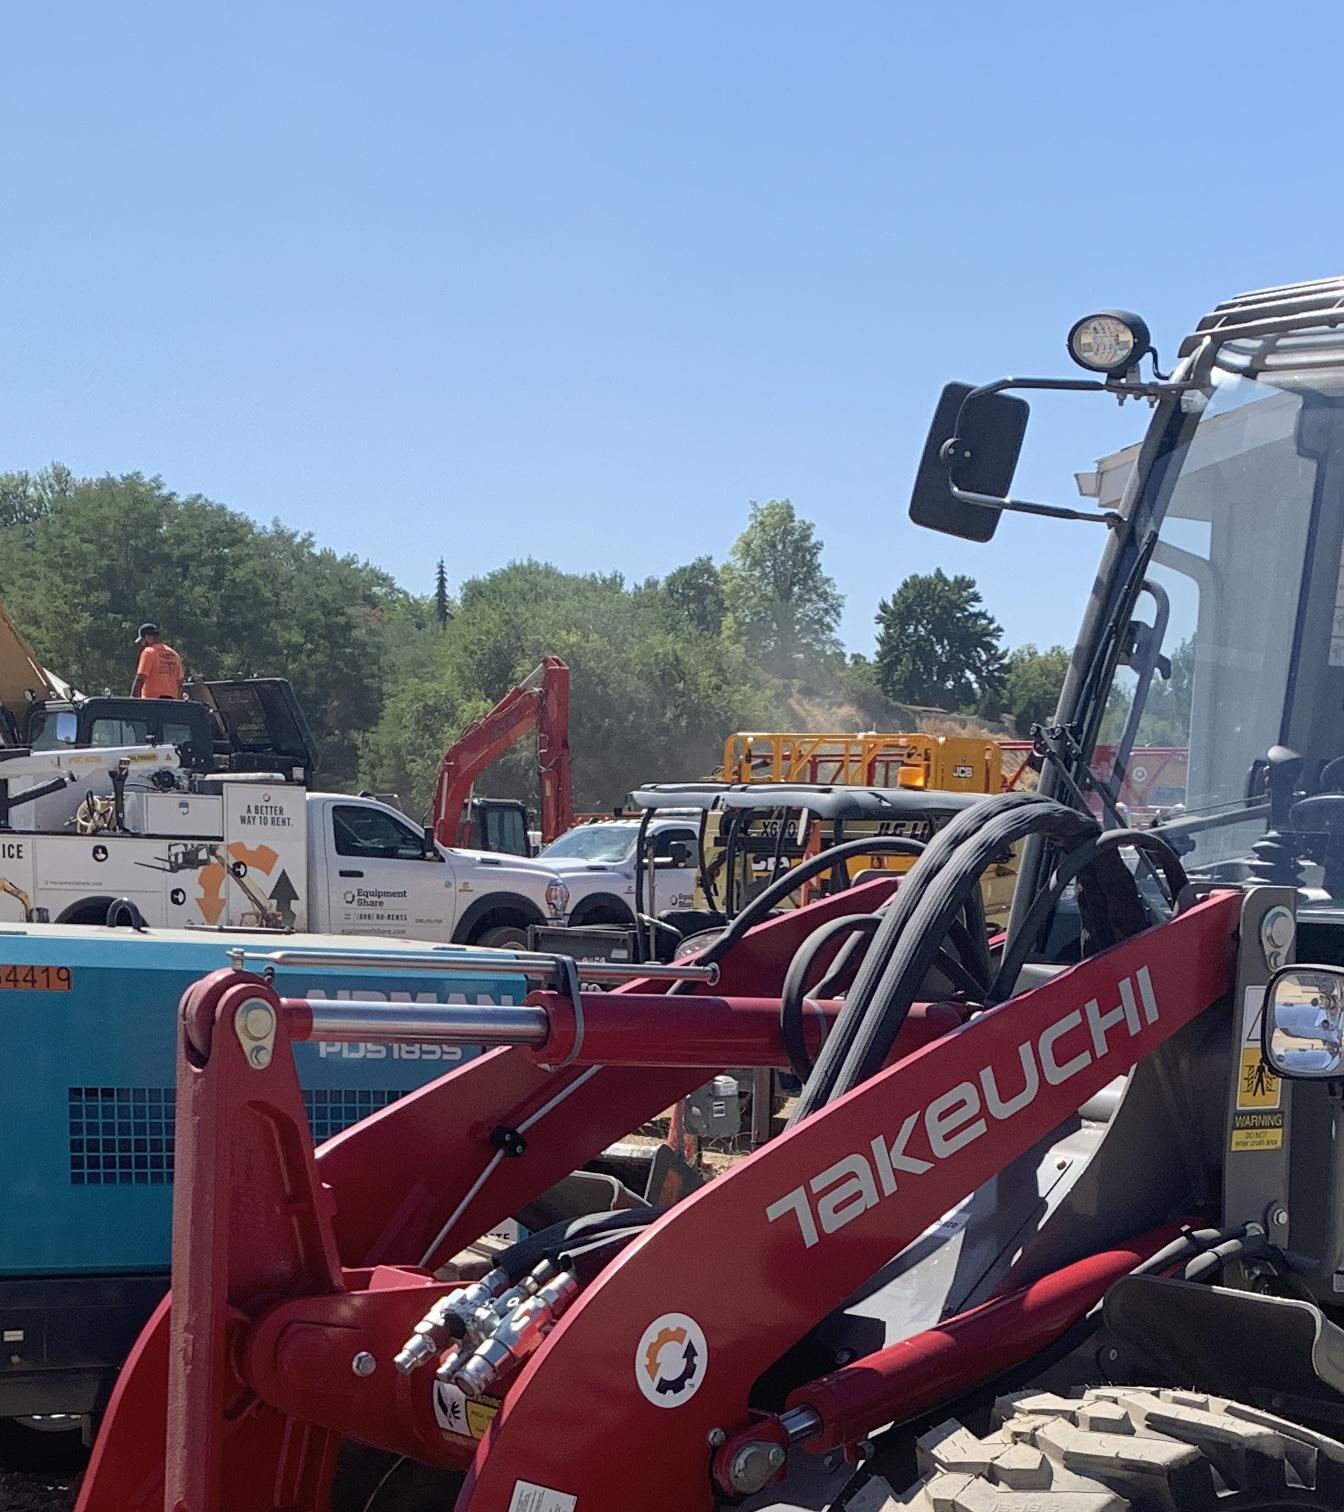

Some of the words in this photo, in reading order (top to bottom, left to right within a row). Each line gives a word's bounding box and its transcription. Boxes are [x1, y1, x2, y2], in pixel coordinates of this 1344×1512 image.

[952, 766, 974, 778] JCB
[255, 806, 284, 815] BETTER
[240, 816, 256, 825] WAY
[259, 817, 268, 826] TO
[357, 888, 408, 898] Equipment
[357, 899, 385, 907] Share
[766, 965, 1159, 1249] TAKEUCHI
[1235, 1114, 1282, 1128] WARNING
